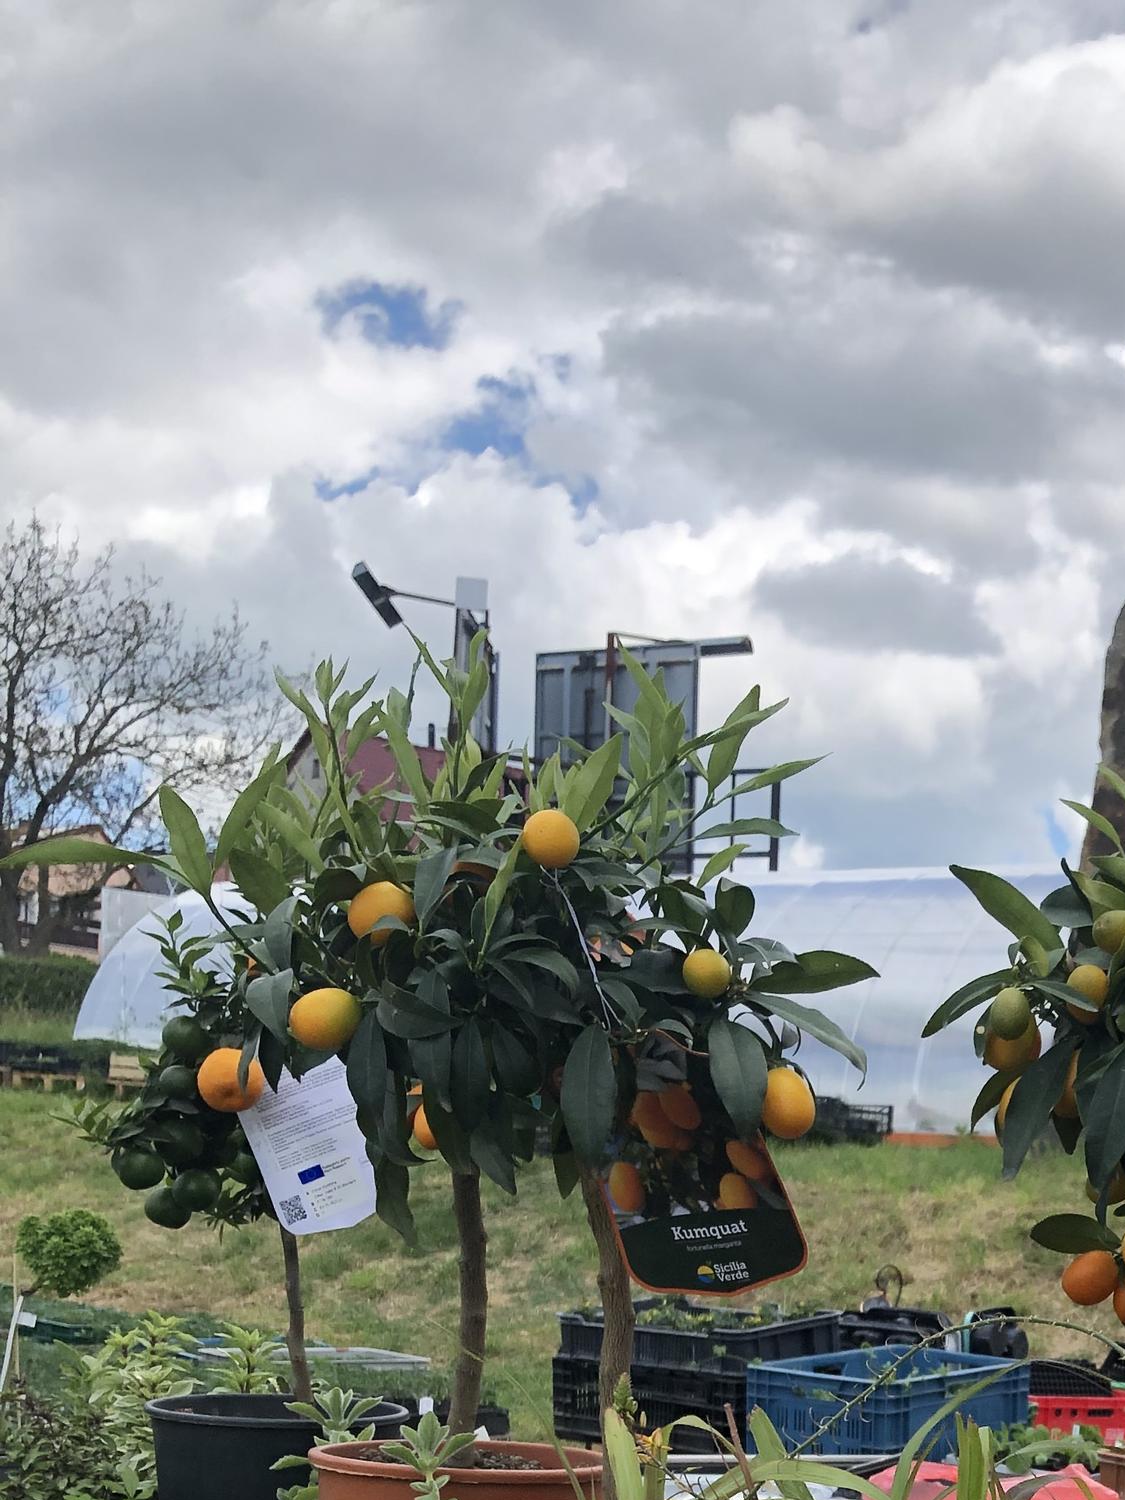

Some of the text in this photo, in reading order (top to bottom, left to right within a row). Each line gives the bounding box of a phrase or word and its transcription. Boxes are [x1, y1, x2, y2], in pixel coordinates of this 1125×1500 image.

[671, 1220, 748, 1240] Kumquat
[713, 1260, 747, 1273] Sicilia
[716, 1270, 750, 1282] Verde
